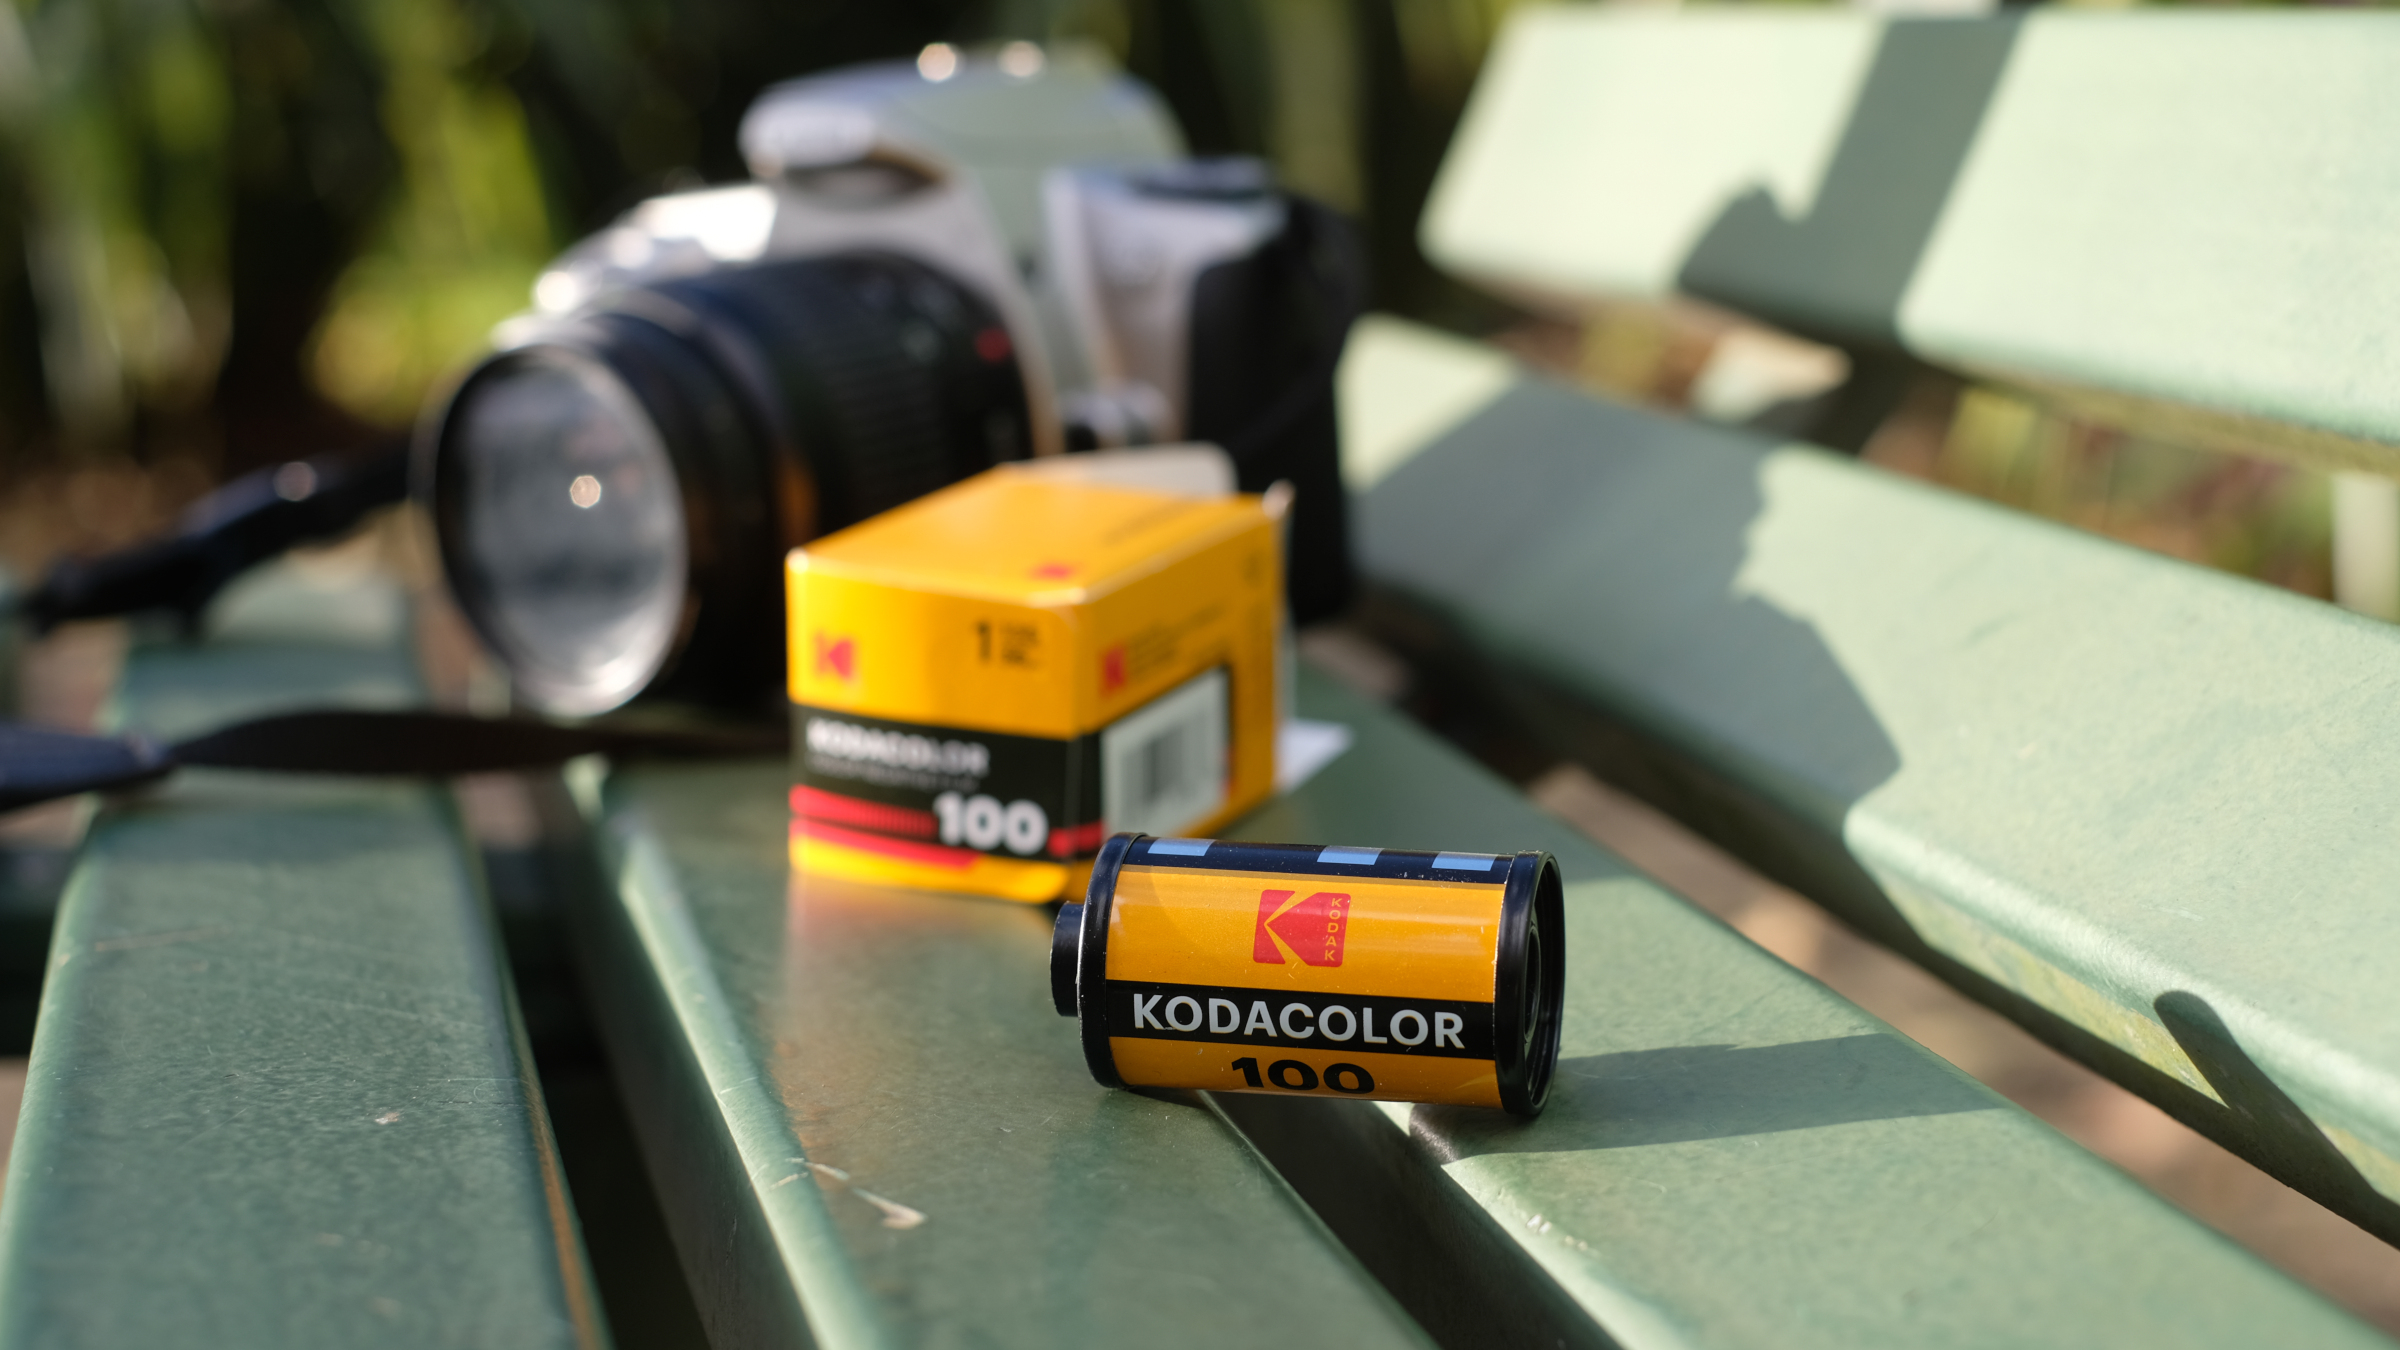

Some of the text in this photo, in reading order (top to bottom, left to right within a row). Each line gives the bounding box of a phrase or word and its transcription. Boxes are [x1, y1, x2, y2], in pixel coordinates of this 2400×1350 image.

[933, 791, 1046, 855] 100
[1324, 897, 1343, 962] KODAK
[1133, 993, 1465, 1048] KODACOLOR
[1231, 1057, 1375, 1094] 100
